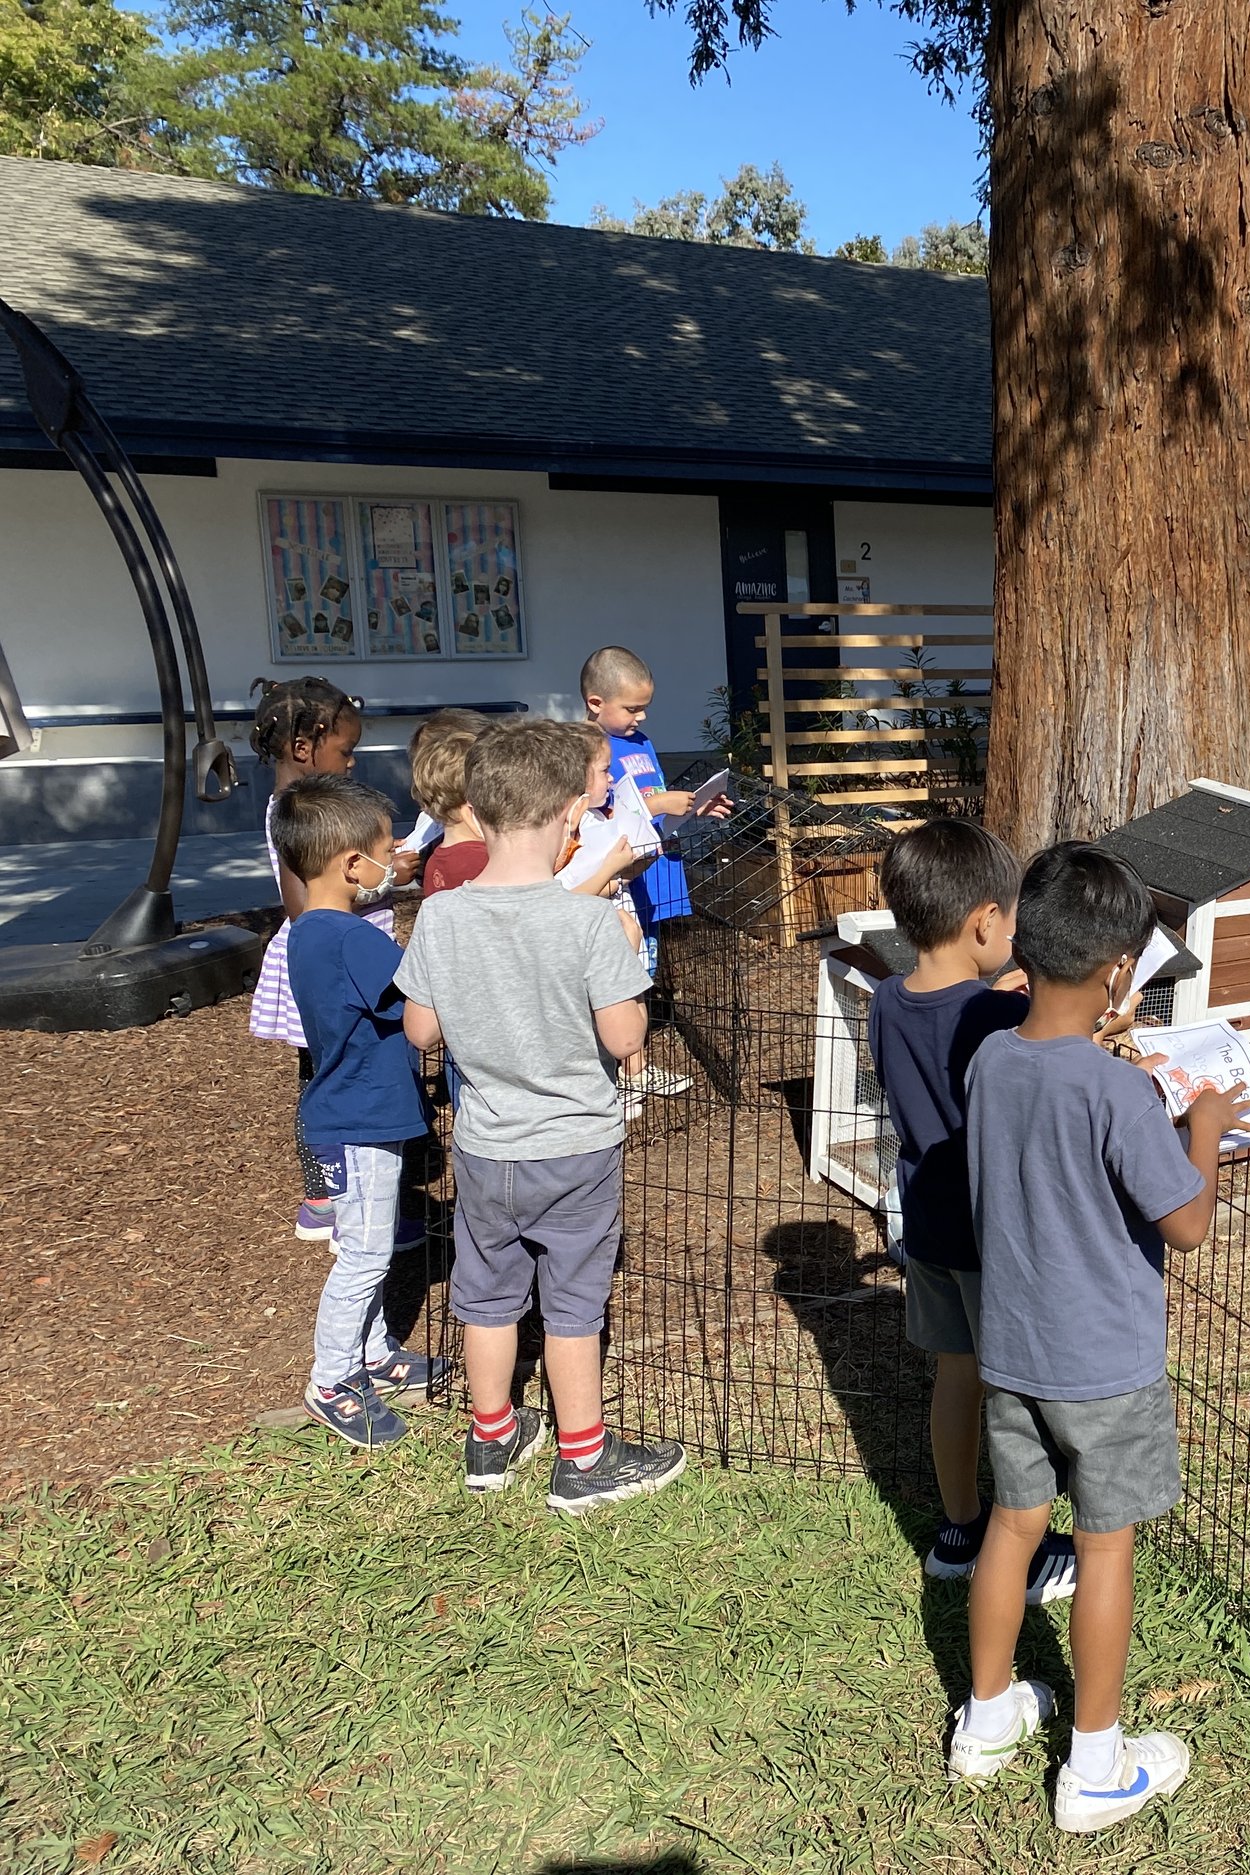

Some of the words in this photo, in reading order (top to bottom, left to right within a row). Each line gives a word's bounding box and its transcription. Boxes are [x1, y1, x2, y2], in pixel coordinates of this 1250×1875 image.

[739, 547, 767, 563] Believe
[860, 542, 871, 560] 2
[735, 581, 777, 597] AMAZING
[1216, 1042, 1233, 1064] The
[1229, 1067, 1250, 1100] Bas
[954, 1740, 974, 1756] NIKE
